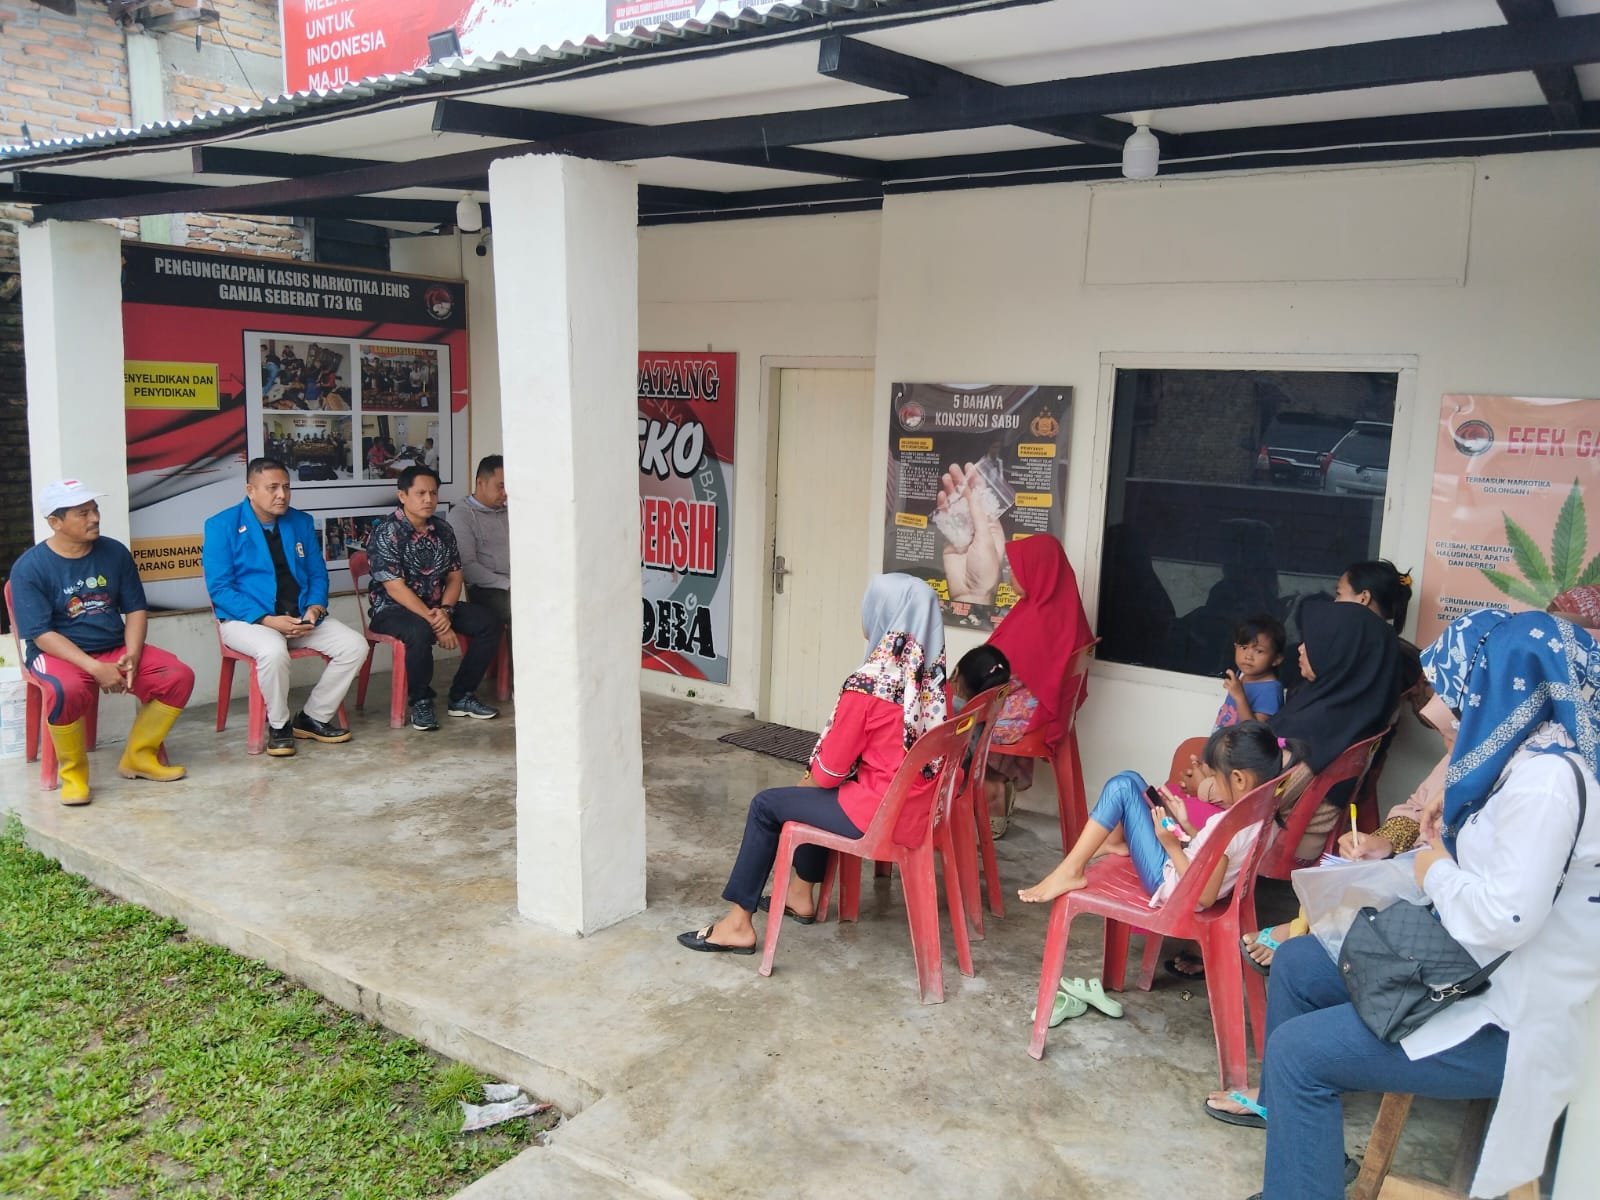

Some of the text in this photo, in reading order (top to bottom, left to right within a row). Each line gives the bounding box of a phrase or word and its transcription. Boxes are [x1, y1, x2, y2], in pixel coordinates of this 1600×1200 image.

[306, 9, 355, 40] UNTUK
[307, 29, 386, 66] INDONESIA
[308, 66, 349, 91] MAJU
[155, 257, 410, 299] PENGUNGKAPAN KASUS NARKOTIKA JENIS
[219, 284, 362, 312] GANJA SEBERAT 173 KG
[124, 374, 213, 385] ENYELIDIKAN DAN
[638, 360, 720, 400] ATANG
[134, 387, 196, 398] PENYIDIKAN
[953, 394, 1004, 410] 5 BAHAYA
[935, 412, 1020, 429] KONSUMSI SABU
[1507, 426, 1566, 457] EFEK
[1465, 476, 1551, 488] TERMASUK NARKOTIKA
[1483, 486, 1526, 495] GOLONGAN
[133, 546, 203, 559] PEMUSNAHAN
[1470, 544, 1513, 554] KETAKUTAN
[1484, 554, 1510, 562] APATIS
[137, 560, 175, 571] ARANG
[1465, 561, 1496, 569] DEPRESI
[1440, 597, 1510, 609] PERUBAHAN EMOSI
